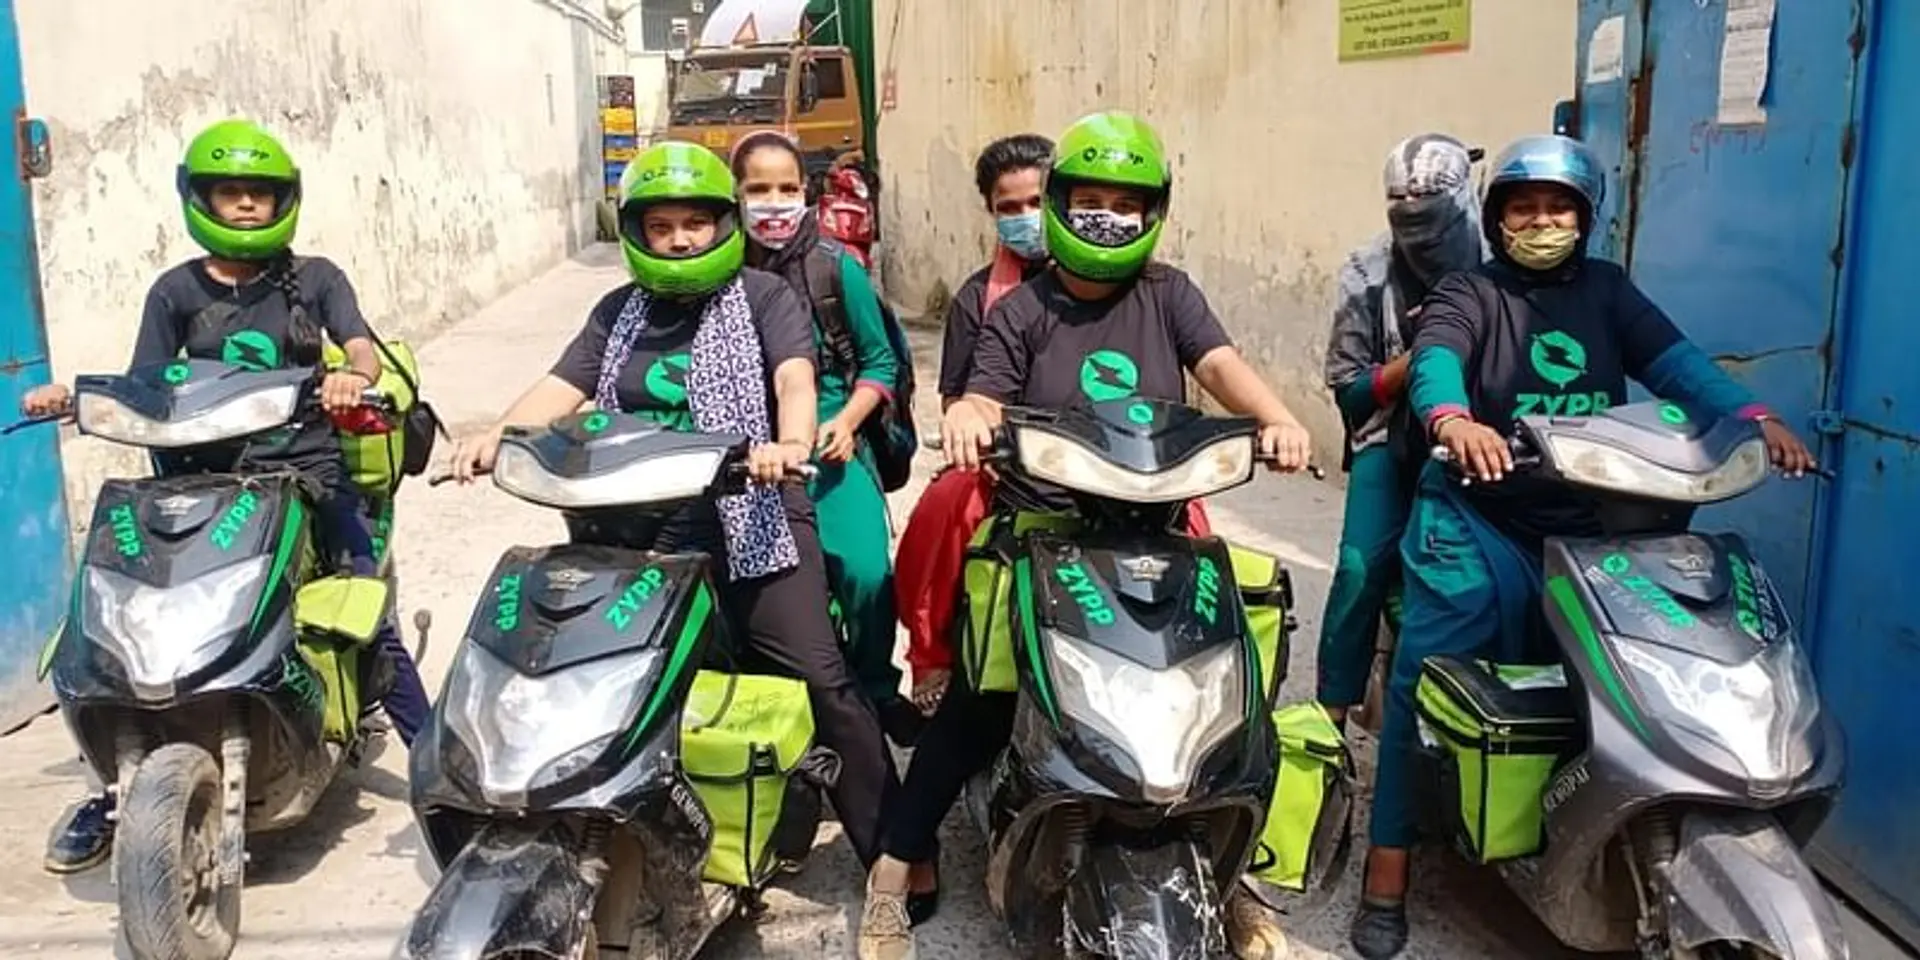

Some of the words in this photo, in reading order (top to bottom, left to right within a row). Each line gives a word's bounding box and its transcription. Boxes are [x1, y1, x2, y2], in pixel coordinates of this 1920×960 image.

[1512, 392, 1609, 419] ZYPP
[109, 503, 142, 557] ZYPP
[211, 490, 257, 549] ZYPP
[496, 574, 520, 632] ZYPP
[606, 567, 663, 630] ZYPP
[1055, 563, 1116, 626] ZYPP
[1193, 556, 1219, 626] ZYPP
[1623, 575, 1697, 628] ZYPP
